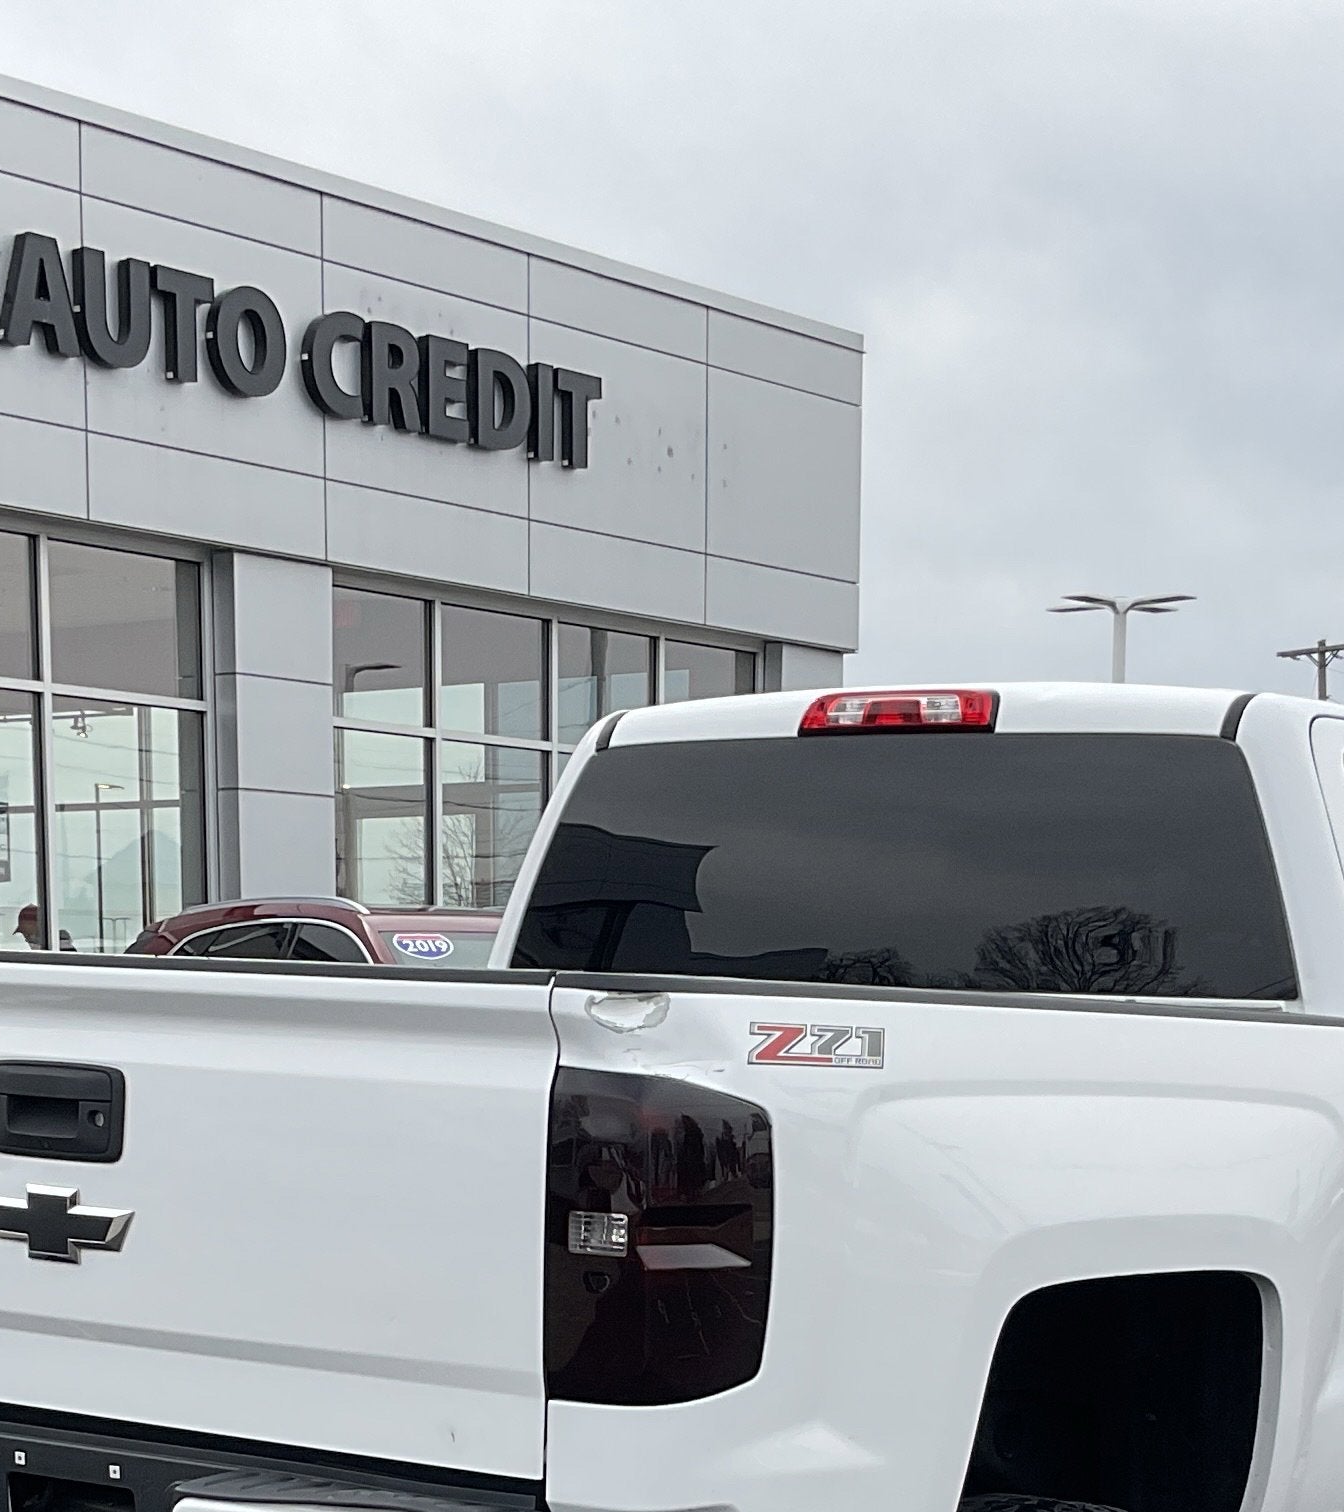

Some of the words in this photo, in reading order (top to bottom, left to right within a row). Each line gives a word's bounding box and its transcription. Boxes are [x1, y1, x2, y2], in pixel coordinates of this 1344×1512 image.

[300, 310, 602, 469] CREDIT
[402, 939, 448, 952] 2019
[747, 1021, 885, 1069] Z71
